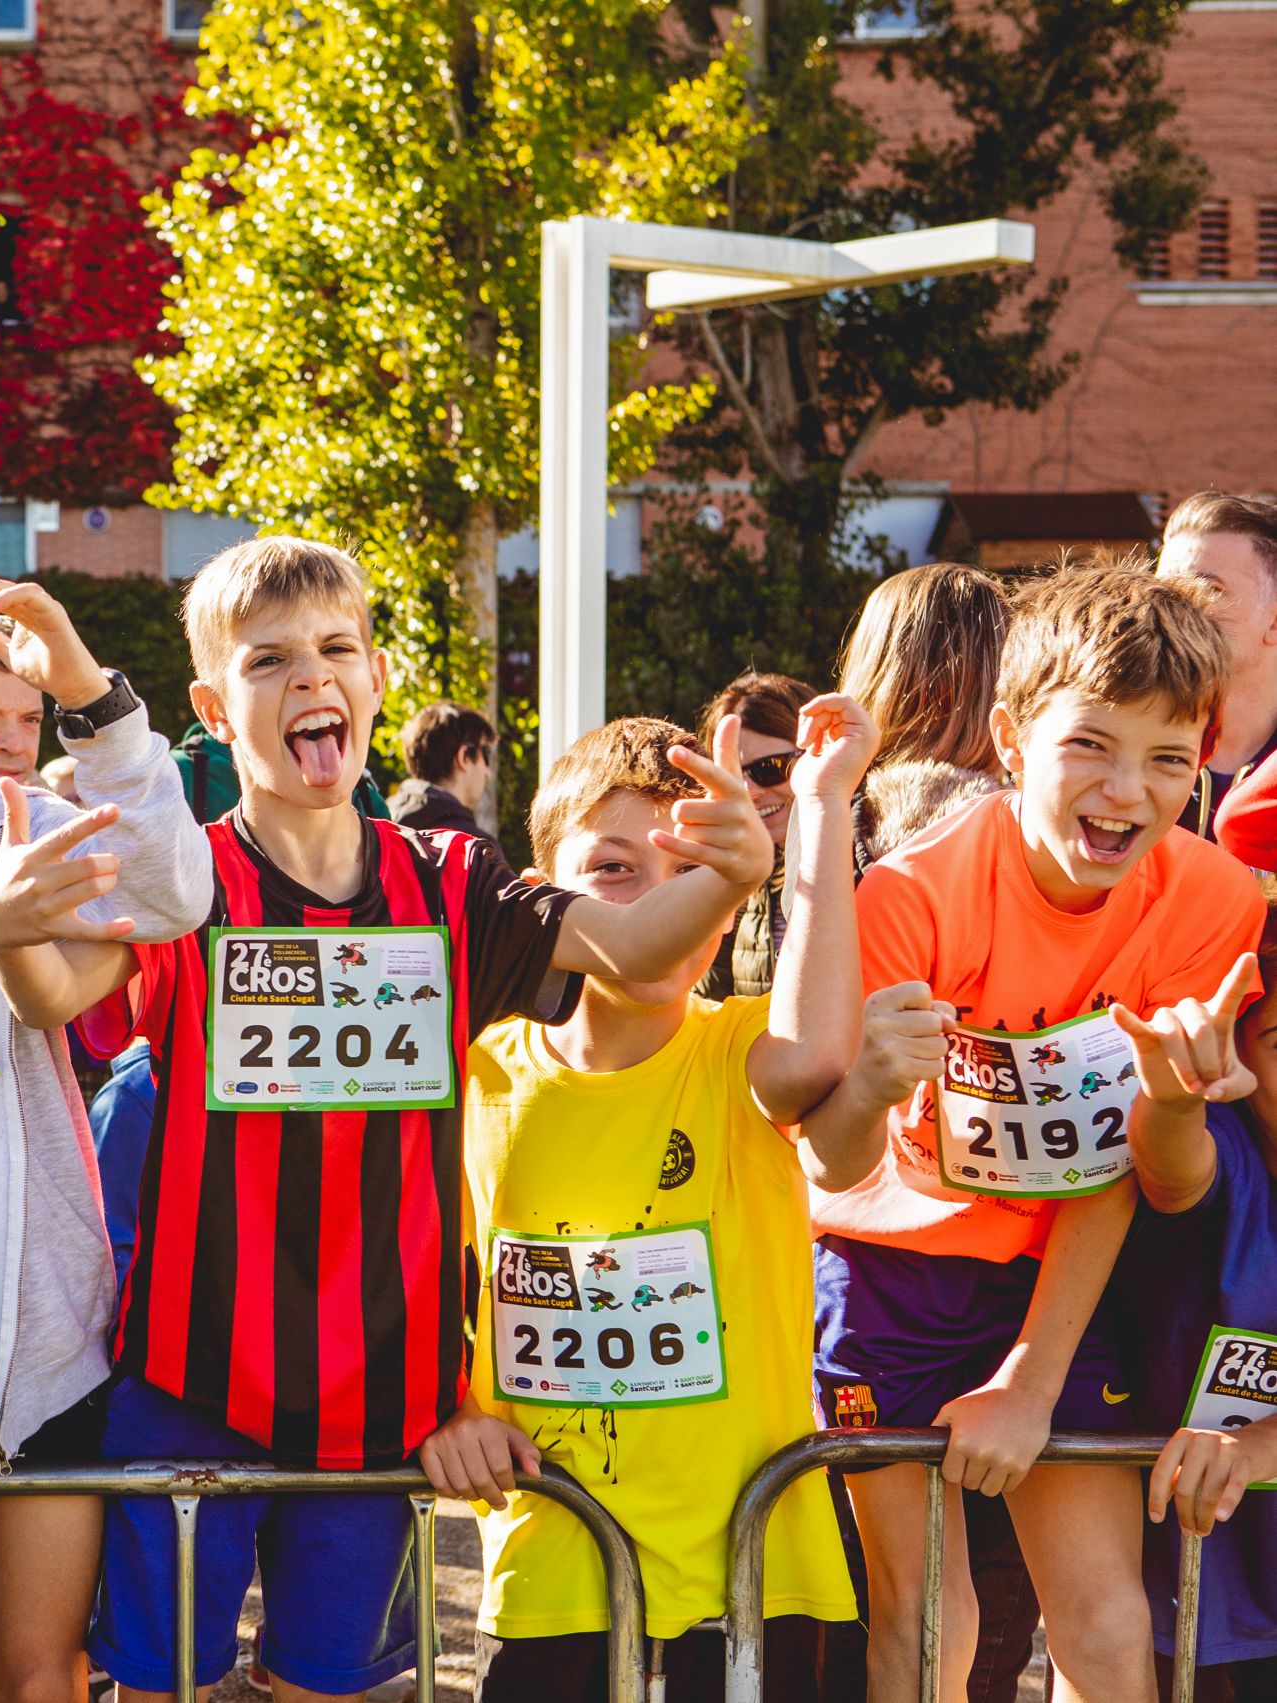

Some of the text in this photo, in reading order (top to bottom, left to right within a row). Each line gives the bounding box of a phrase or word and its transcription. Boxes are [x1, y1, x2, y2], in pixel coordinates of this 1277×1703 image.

[229, 966, 316, 993] CROS
[230, 994, 316, 1004] Ciutat de Sant Cugat
[239, 1024, 419, 1068] 2204
[948, 1055, 1016, 1092] CROS
[949, 1082, 1018, 1102] Ciutat de Sant Cugat
[967, 1106, 1127, 1161] 2192
[1083, 1165, 1119, 1178] SantCugat
[501, 1267, 573, 1298] CROS
[502, 1294, 574, 1308] Ciutat de Sant Cugat
[513, 1322, 684, 1369] 2206
[630, 1385, 666, 1393] SantCugat
[1218, 1363, 1277, 1394] CRO
[1214, 1385, 1240, 1395] Ciutat
[1240, 1389, 1251, 1397] de
[1252, 1391, 1273, 1402] Sant
